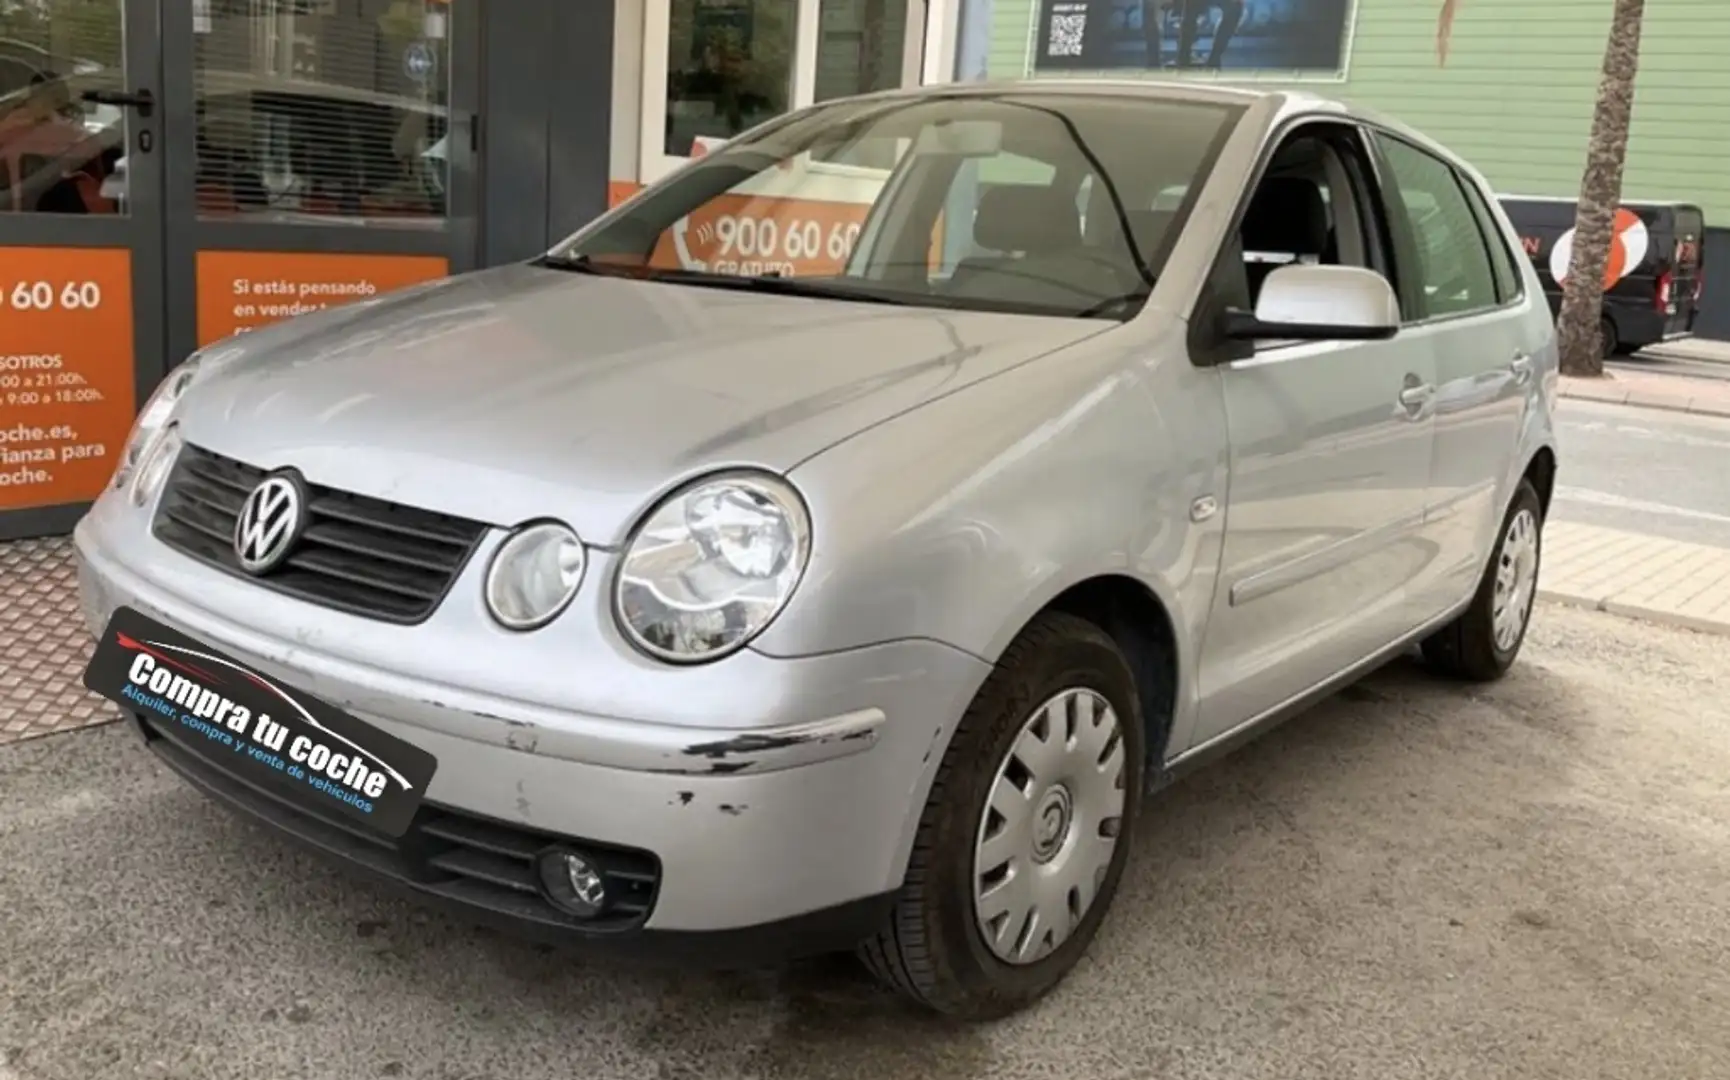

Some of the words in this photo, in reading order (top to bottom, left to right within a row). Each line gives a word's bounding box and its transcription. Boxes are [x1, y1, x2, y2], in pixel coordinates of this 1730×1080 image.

[716, 215, 776, 258] 900
[784, 219, 821, 259] 60
[11, 281, 53, 309] 60
[60, 281, 100, 309] 60
[233, 279, 249, 295] Si
[252, 281, 296, 295] estás
[300, 280, 376, 298] pensando
[233, 304, 255, 317] en
[61, 443, 105, 464] para
